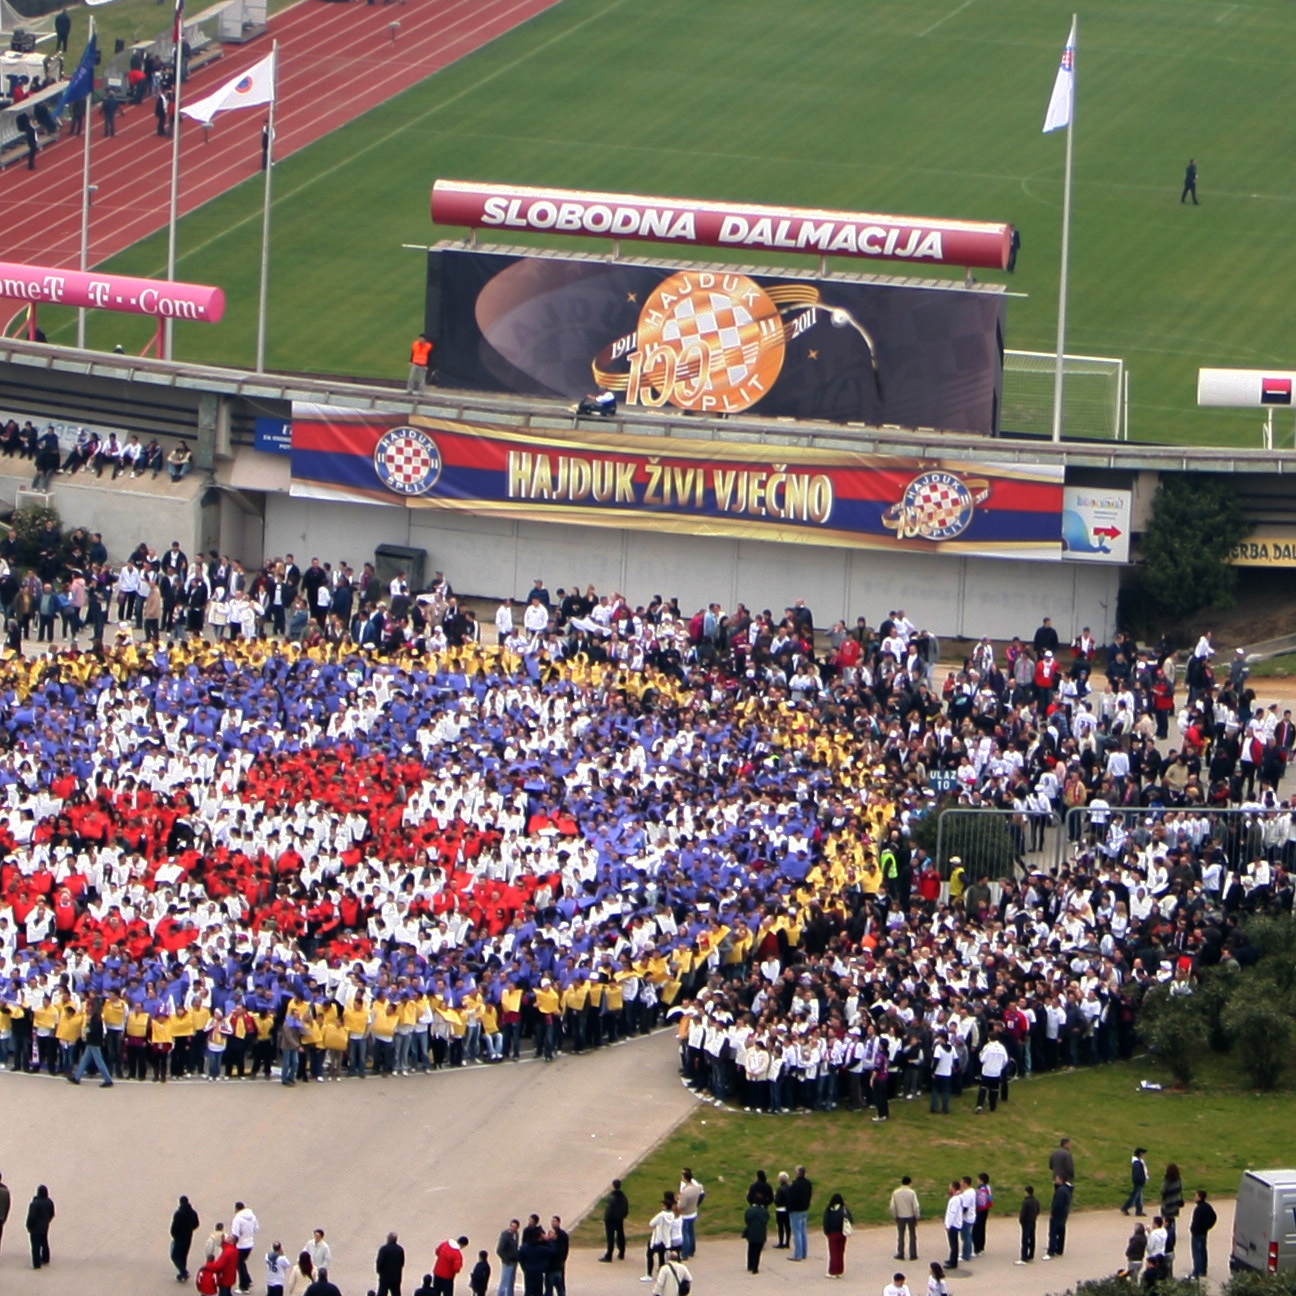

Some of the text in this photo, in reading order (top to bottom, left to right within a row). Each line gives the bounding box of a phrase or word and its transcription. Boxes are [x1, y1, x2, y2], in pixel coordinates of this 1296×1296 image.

[482, 196, 944, 260] SLOBODNA DALMACIJA
[645, 273, 760, 327] HAJDUK
[791, 307, 817, 339] 2011
[611, 332, 638, 359] 1911
[382, 429, 435, 452] HAJDUK
[386, 476, 426, 493] SPLIT
[508, 450, 833, 524] HAJDUK ŽIVI VJEČNO
[907, 474, 961, 500] HAJDUK
